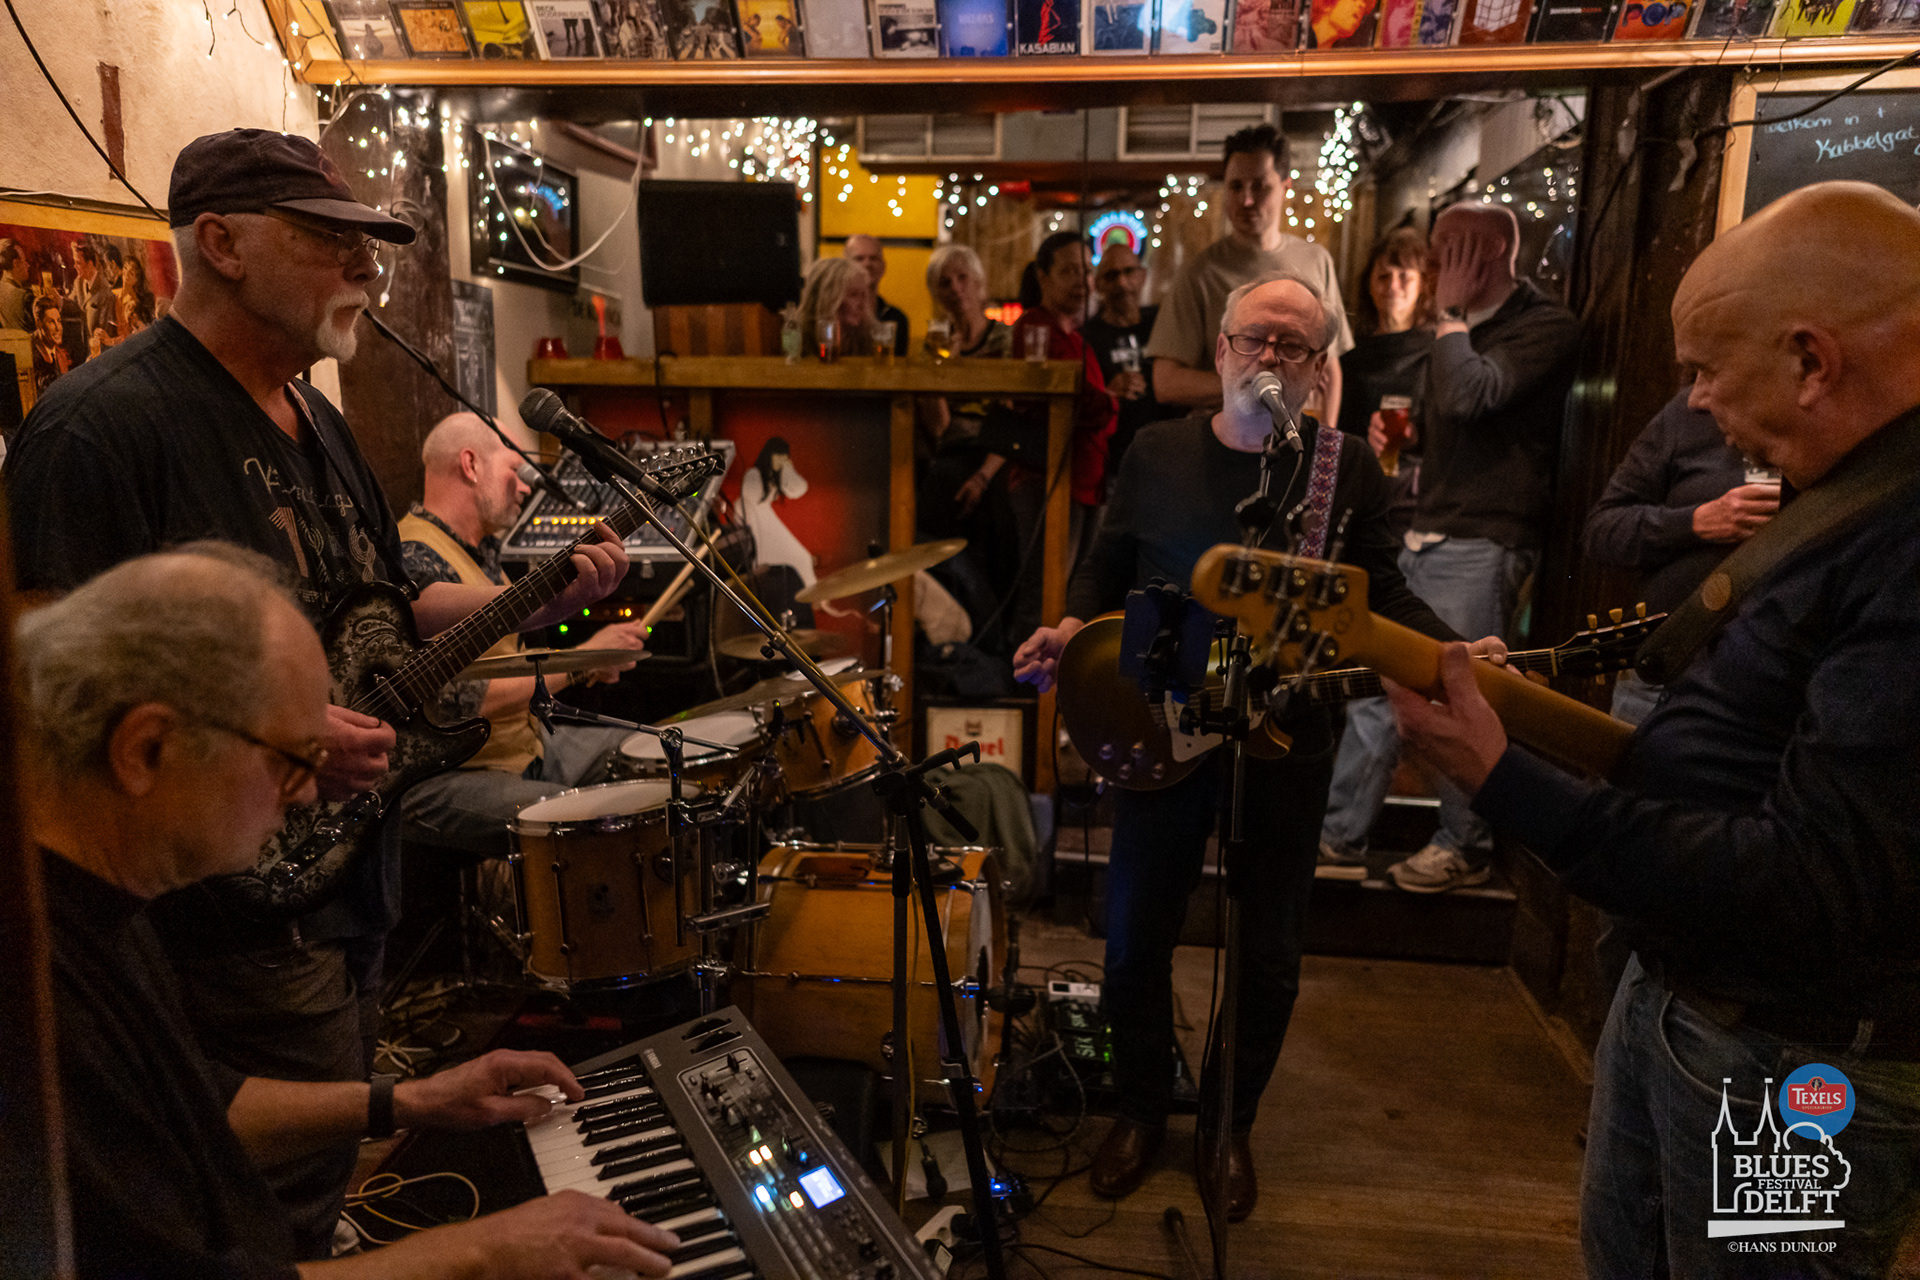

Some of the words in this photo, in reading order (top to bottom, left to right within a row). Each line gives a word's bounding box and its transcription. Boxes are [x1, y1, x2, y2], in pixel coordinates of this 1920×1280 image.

[1019, 42, 1076, 55] KASABIAN
[1844, 115, 1859, 126] in
[945, 734, 1004, 756] Dvel
